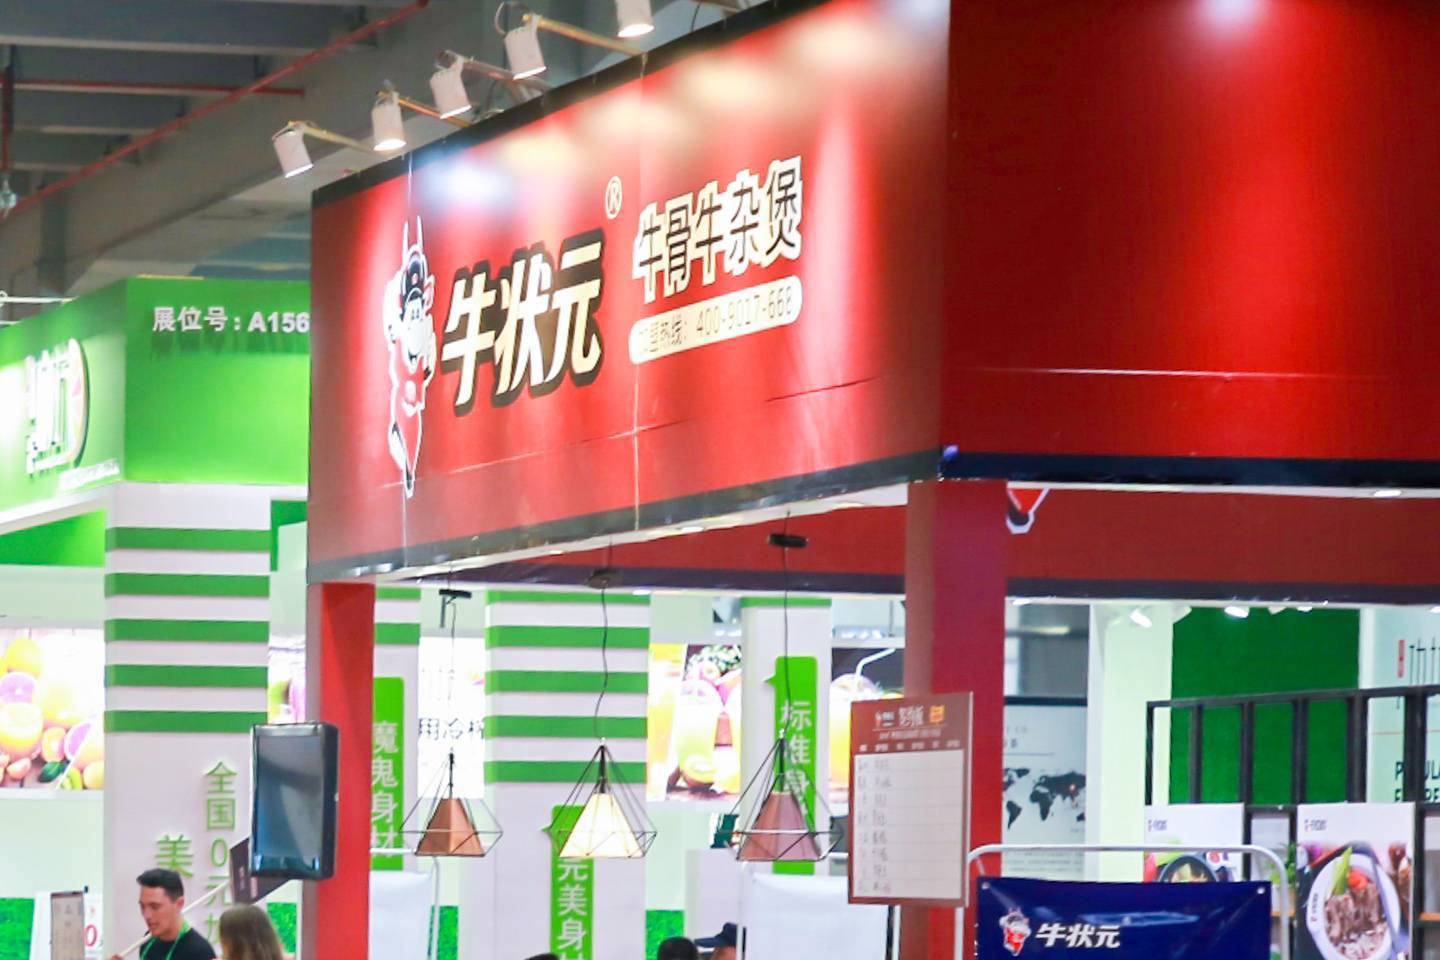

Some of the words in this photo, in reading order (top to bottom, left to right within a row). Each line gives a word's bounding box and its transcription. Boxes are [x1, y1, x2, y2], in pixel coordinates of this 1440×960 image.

[634, 155, 803, 303] 牛骨牛杂煲
[440, 234, 604, 410] 牛状元
[780, 700, 812, 818] 标准身
[1036, 923, 1121, 949] 牛状元
